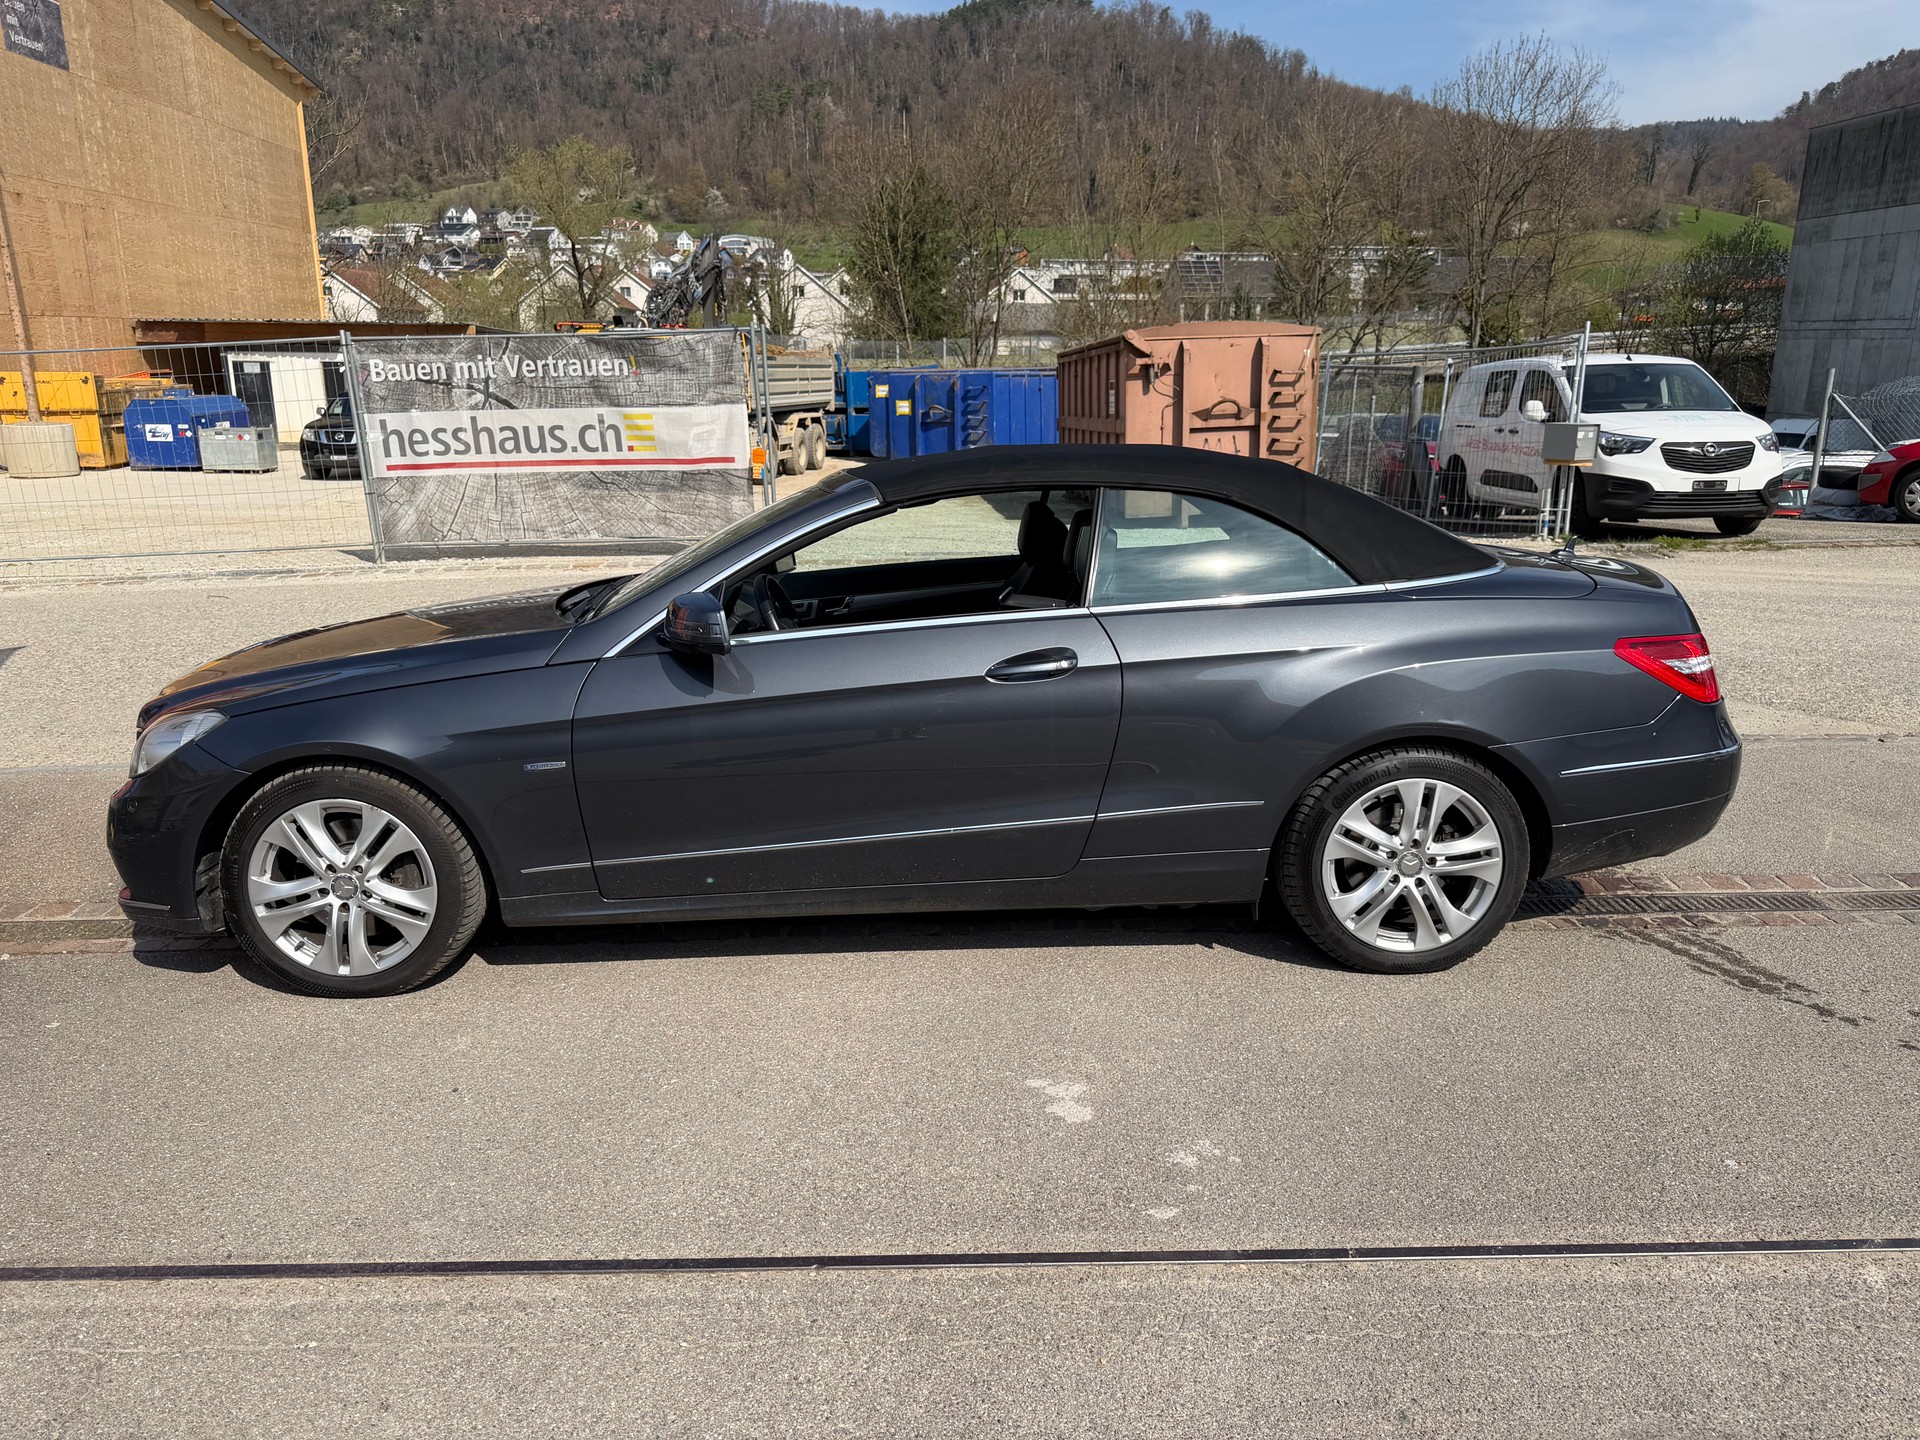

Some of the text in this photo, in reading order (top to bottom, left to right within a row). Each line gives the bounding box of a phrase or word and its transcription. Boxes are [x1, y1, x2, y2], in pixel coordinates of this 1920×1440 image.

[369, 354, 639, 382] Bauen mit Vertrauen!
[379, 413, 624, 458] hesshaus.ch
